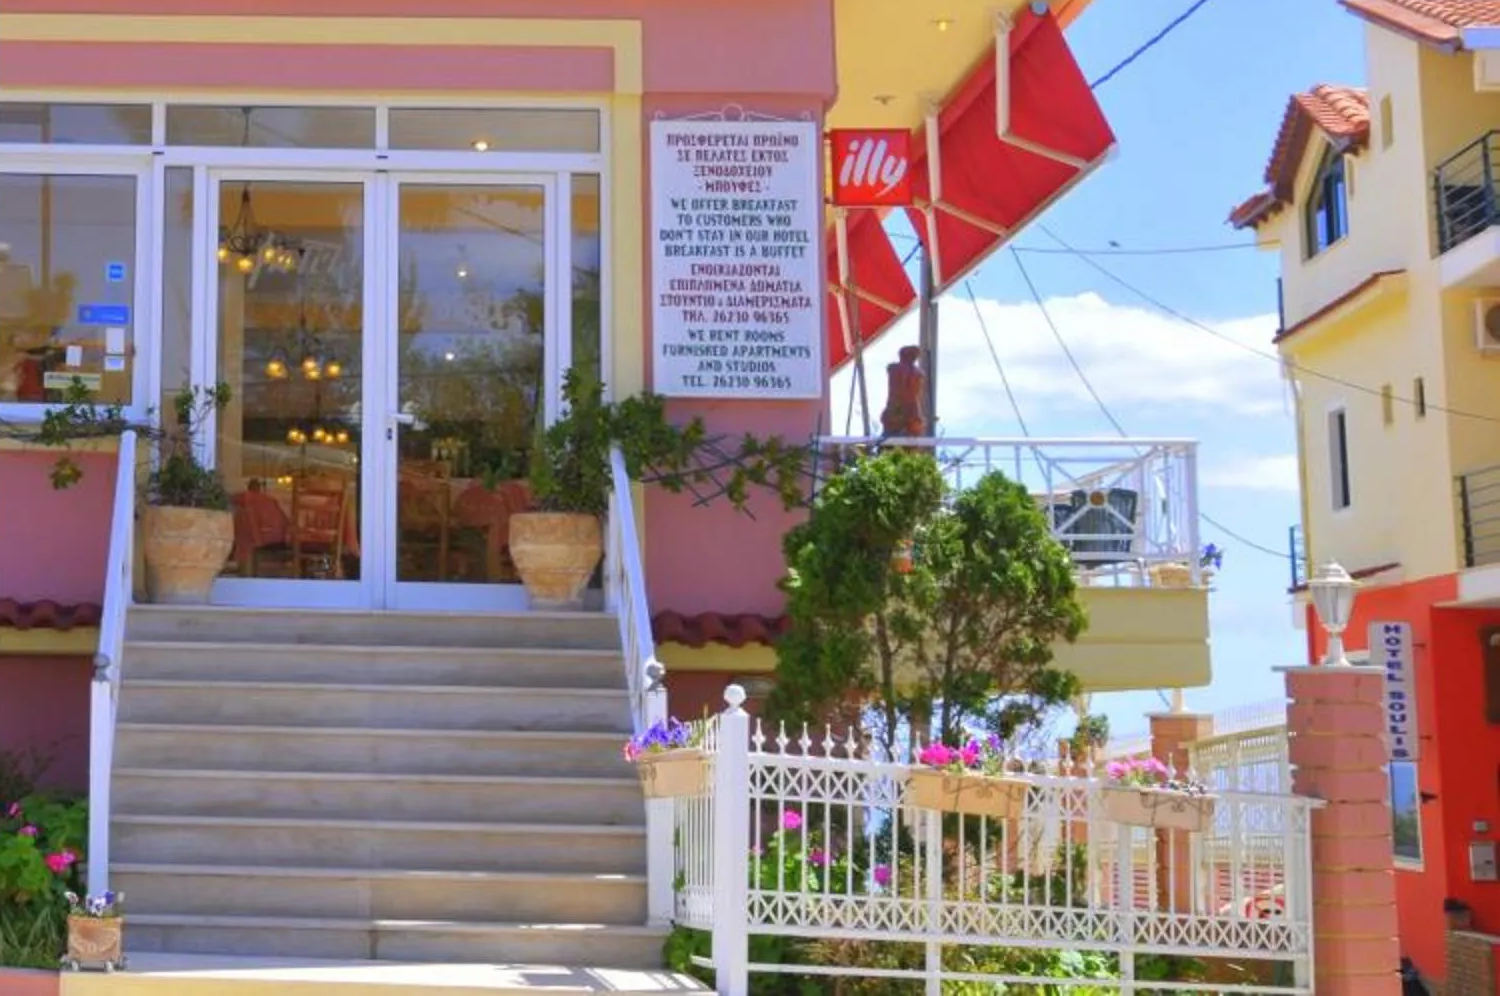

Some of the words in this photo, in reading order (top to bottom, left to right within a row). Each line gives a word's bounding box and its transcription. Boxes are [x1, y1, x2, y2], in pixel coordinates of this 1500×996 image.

[677, 149, 690, 162] ΣΕ
[695, 150, 747, 162] ΠΕΛΑΤΕΣ
[751, 150, 789, 162] ΕΚΤΟΣ
[693, 165, 772, 177] ΞΕΝΟΔΟΧΕΙΟΥ
[839, 136, 907, 198] illy
[671, 198, 686, 210] WE
[691, 198, 728, 211] OFFER
[732, 199, 798, 211] BREAKFAST
[677, 213, 693, 226] TO
[696, 214, 762, 226] CUSTOMERS
[766, 214, 791, 226] WHO
[697, 230, 724, 241] STAY
[729, 230, 741, 242] IN
[746, 230, 769, 242] OUR
[774, 230, 809, 243] HOTEL
[665, 245, 730, 257] BREAKFAST
[735, 246, 745, 257] IS
[750, 246, 757, 257] A
[762, 246, 805, 258] BUFFET
[691, 263, 780, 276] ΕΝΟΙΚΙΑΖΟΝΤΑΙ
[713, 310, 749, 323] 26230
[687, 329, 704, 341] WE
[709, 329, 739, 341] RENT
[744, 330, 785, 342] ROOMS
[663, 343, 728, 356] FURNISHED
[732, 345, 811, 358] APARTMENTS
[698, 360, 723, 372] AND
[725, 360, 776, 372] STUDIOS
[713, 375, 750, 387] 26230
[1383, 624, 1405, 683] HOTEL
